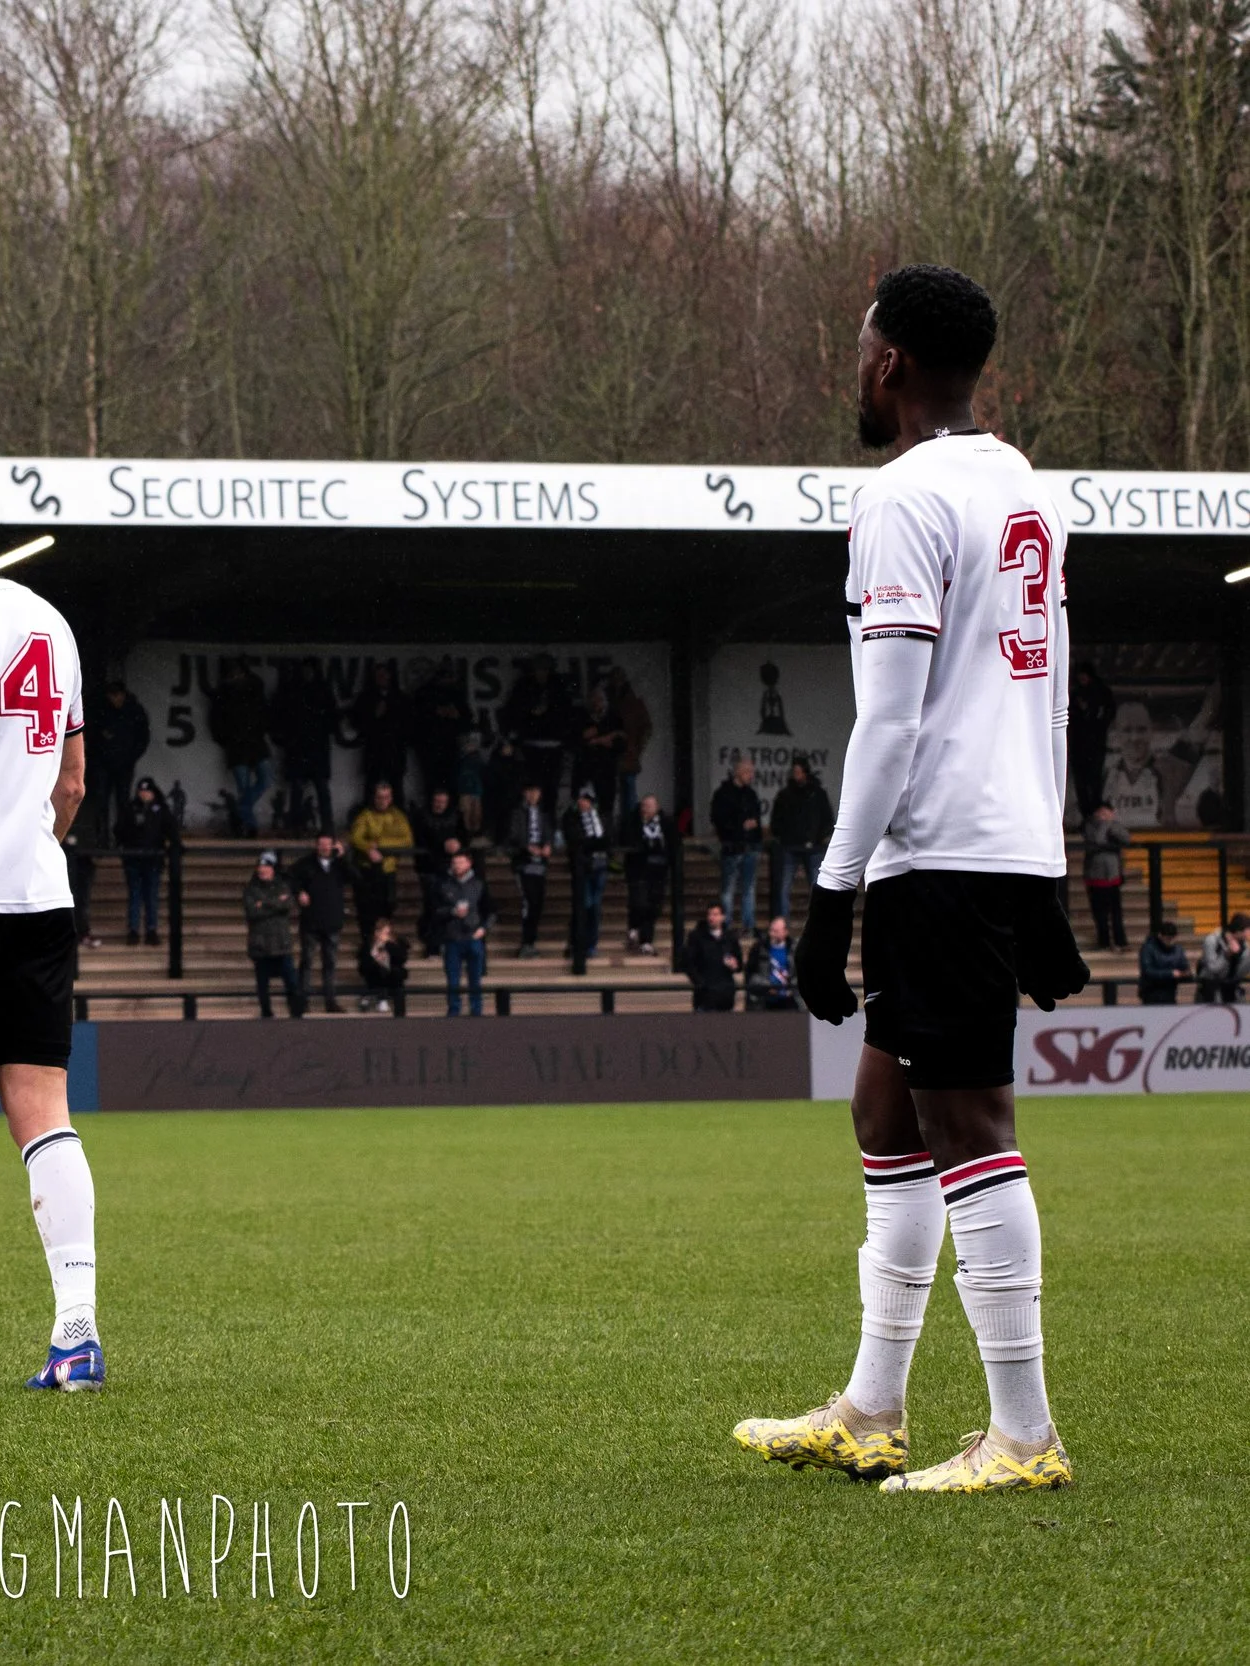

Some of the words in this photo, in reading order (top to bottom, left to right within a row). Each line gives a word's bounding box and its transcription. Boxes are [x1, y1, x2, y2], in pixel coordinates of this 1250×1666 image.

[109, 465, 349, 521] SECURITEC
[401, 469, 599, 523] SYSTEMS
[998, 510, 1053, 681] 3
